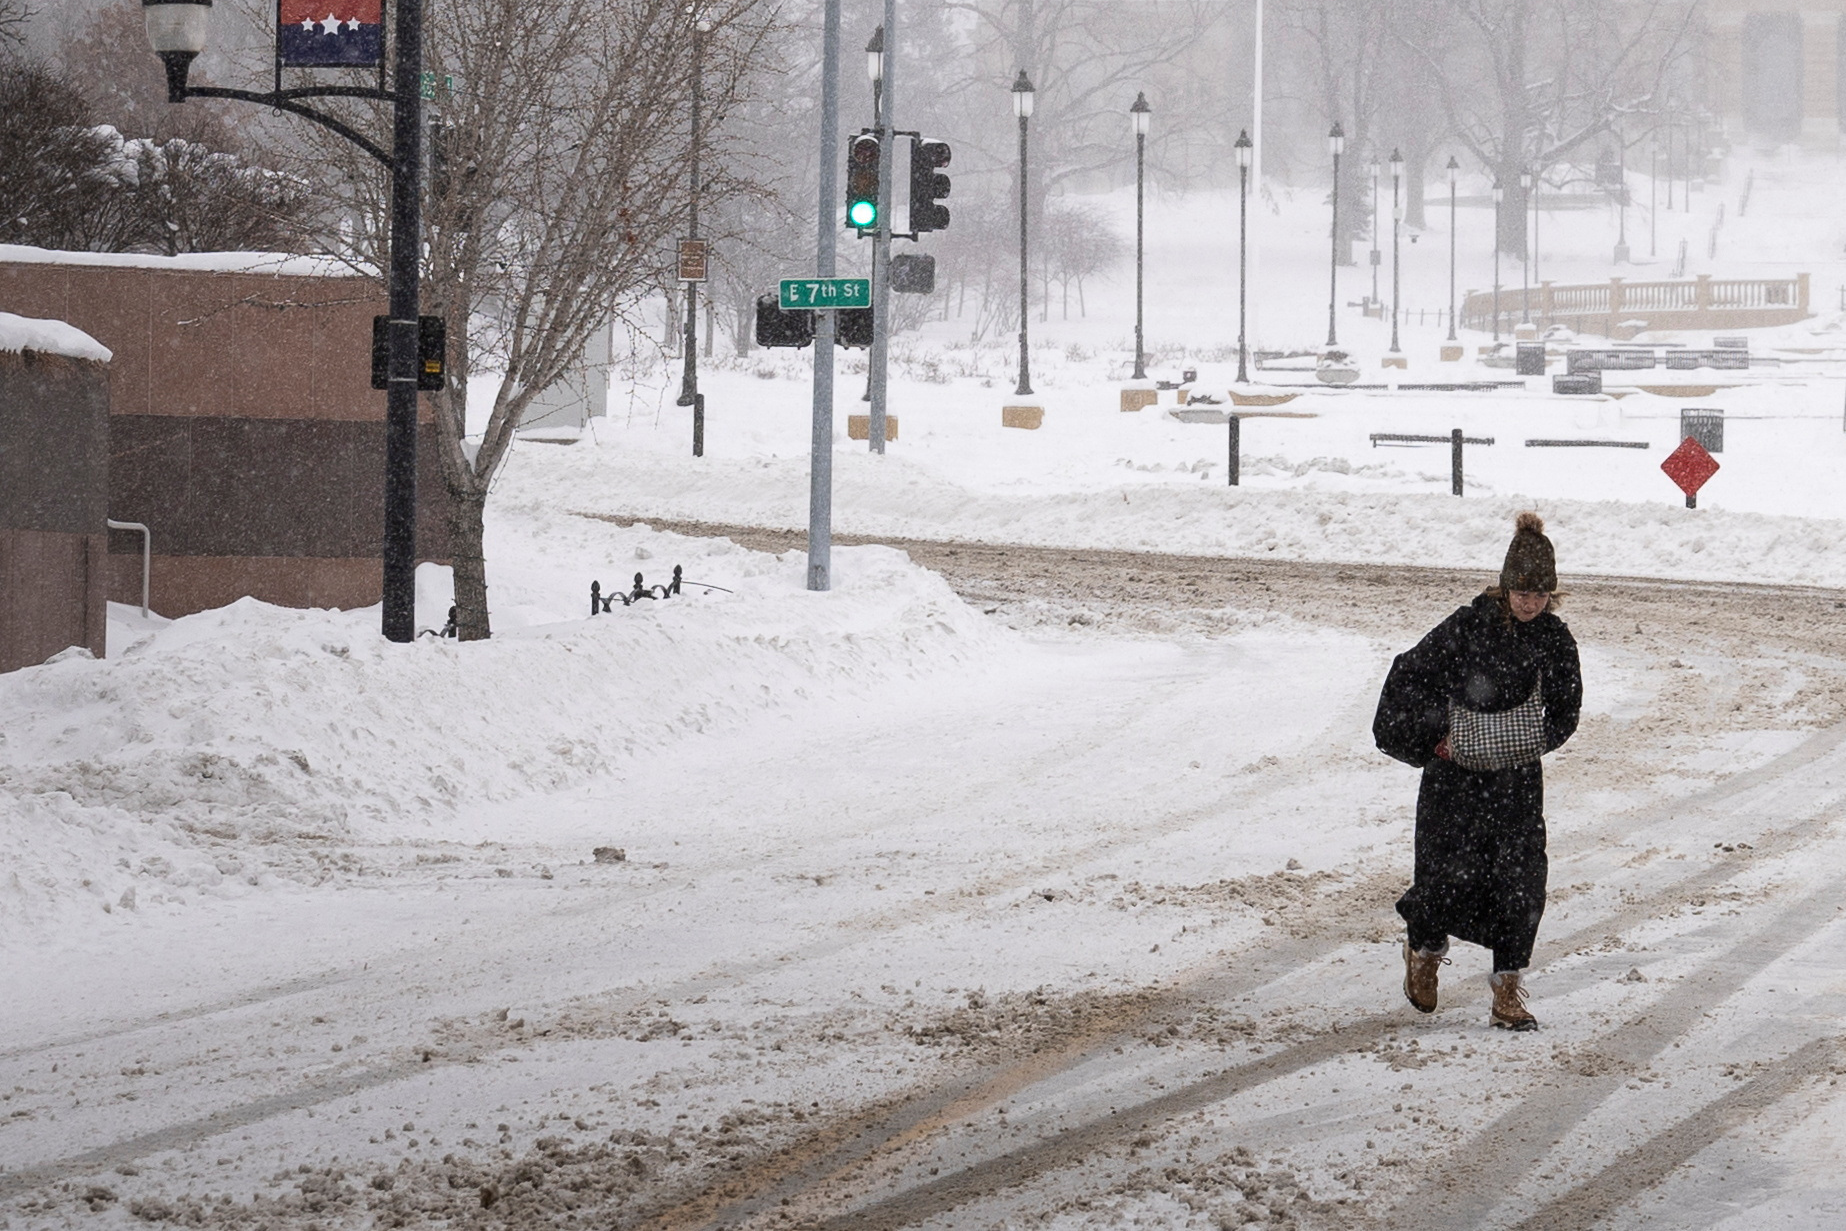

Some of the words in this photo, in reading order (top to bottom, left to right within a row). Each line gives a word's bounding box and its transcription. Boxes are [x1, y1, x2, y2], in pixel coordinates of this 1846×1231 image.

[789, 284, 799, 302] E
[806, 283, 837, 303] 7th
[843, 283, 860, 297] St
